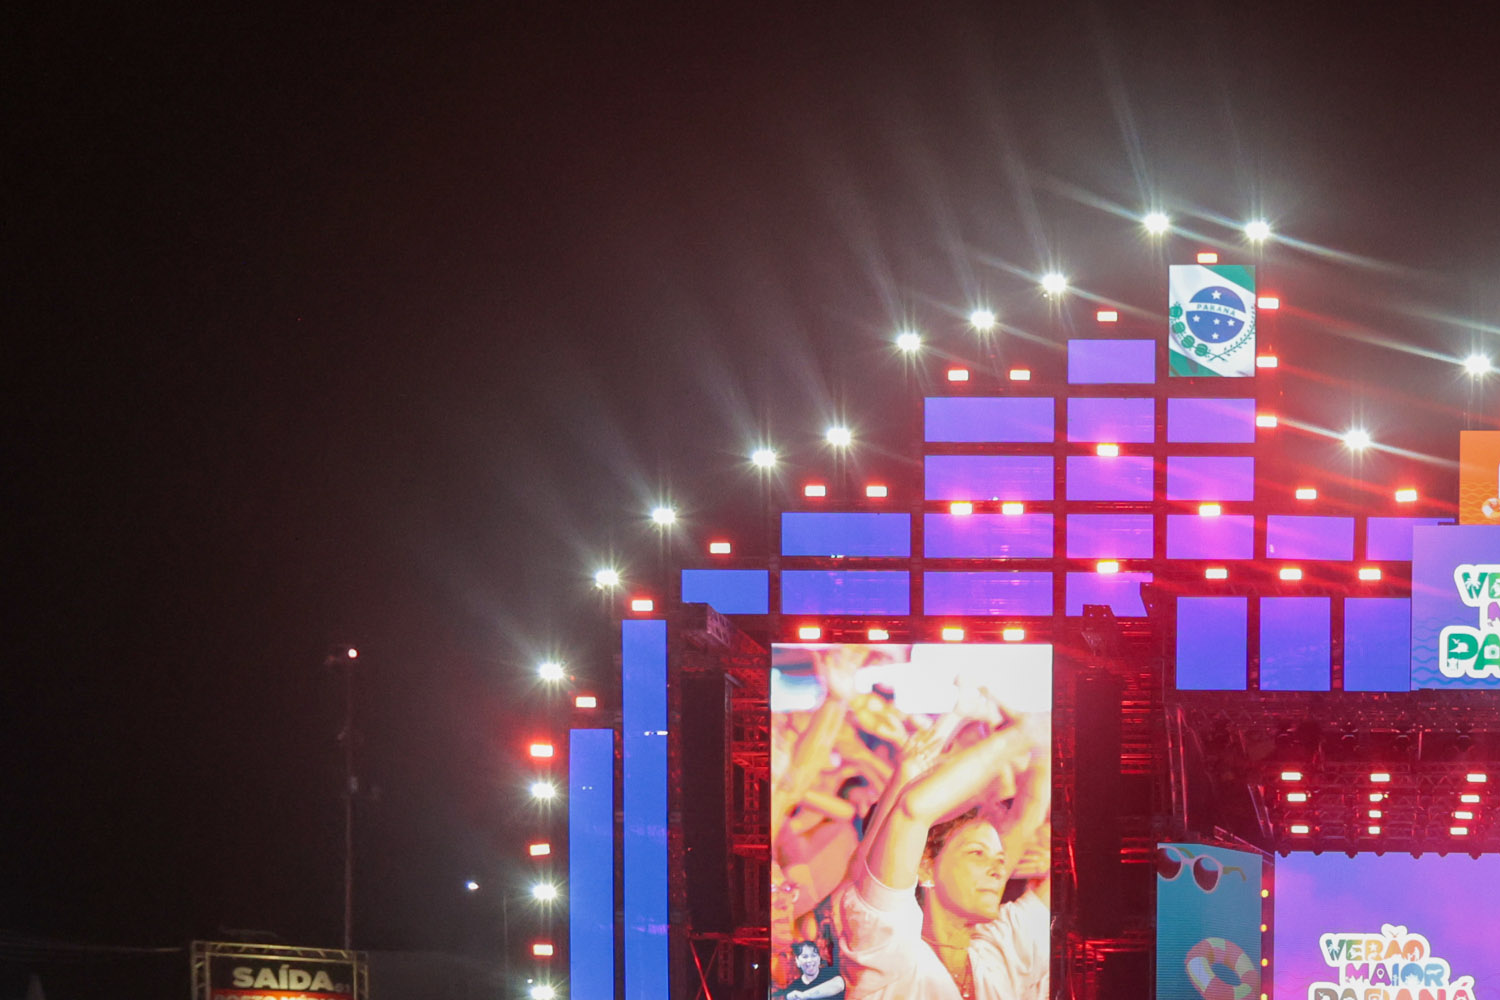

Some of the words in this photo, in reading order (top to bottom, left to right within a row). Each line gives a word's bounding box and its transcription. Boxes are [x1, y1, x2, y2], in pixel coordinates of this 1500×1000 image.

[1325, 930, 1425, 962] VERÃO
[232, 964, 335, 991] SAÍDA
[1345, 963, 1446, 987] MAIOR
